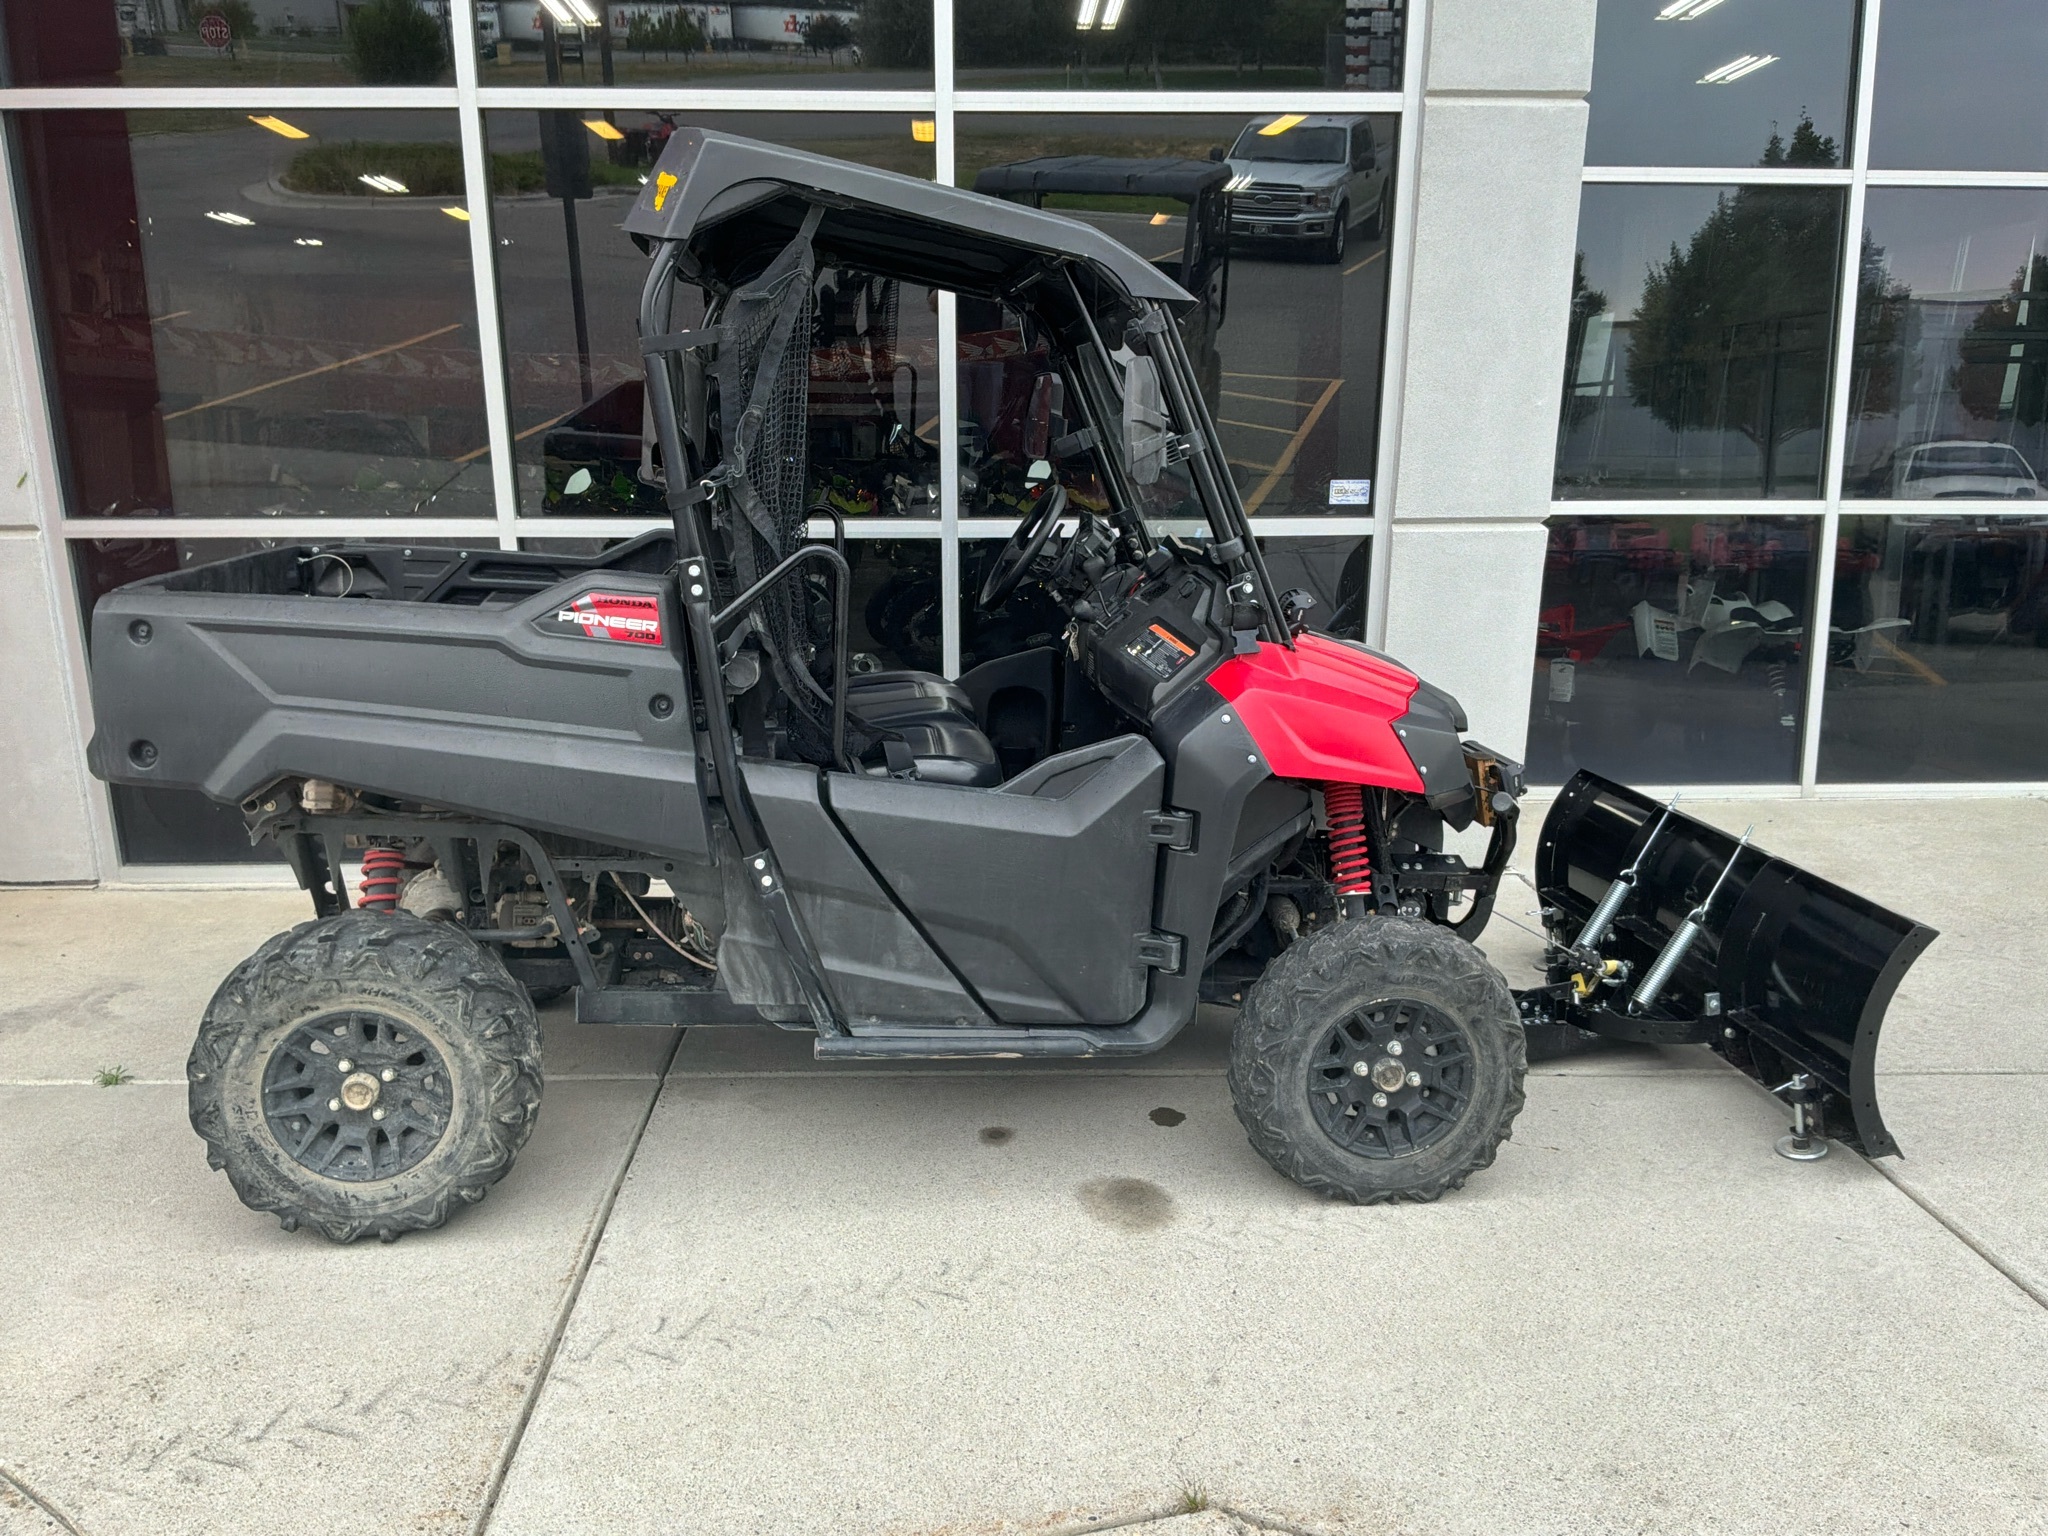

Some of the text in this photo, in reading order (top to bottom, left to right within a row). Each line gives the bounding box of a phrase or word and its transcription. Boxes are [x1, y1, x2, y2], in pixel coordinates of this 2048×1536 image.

[597, 597, 655, 609] HONDA
[558, 610, 658, 632] PIONEER
[624, 630, 656, 640] 700
